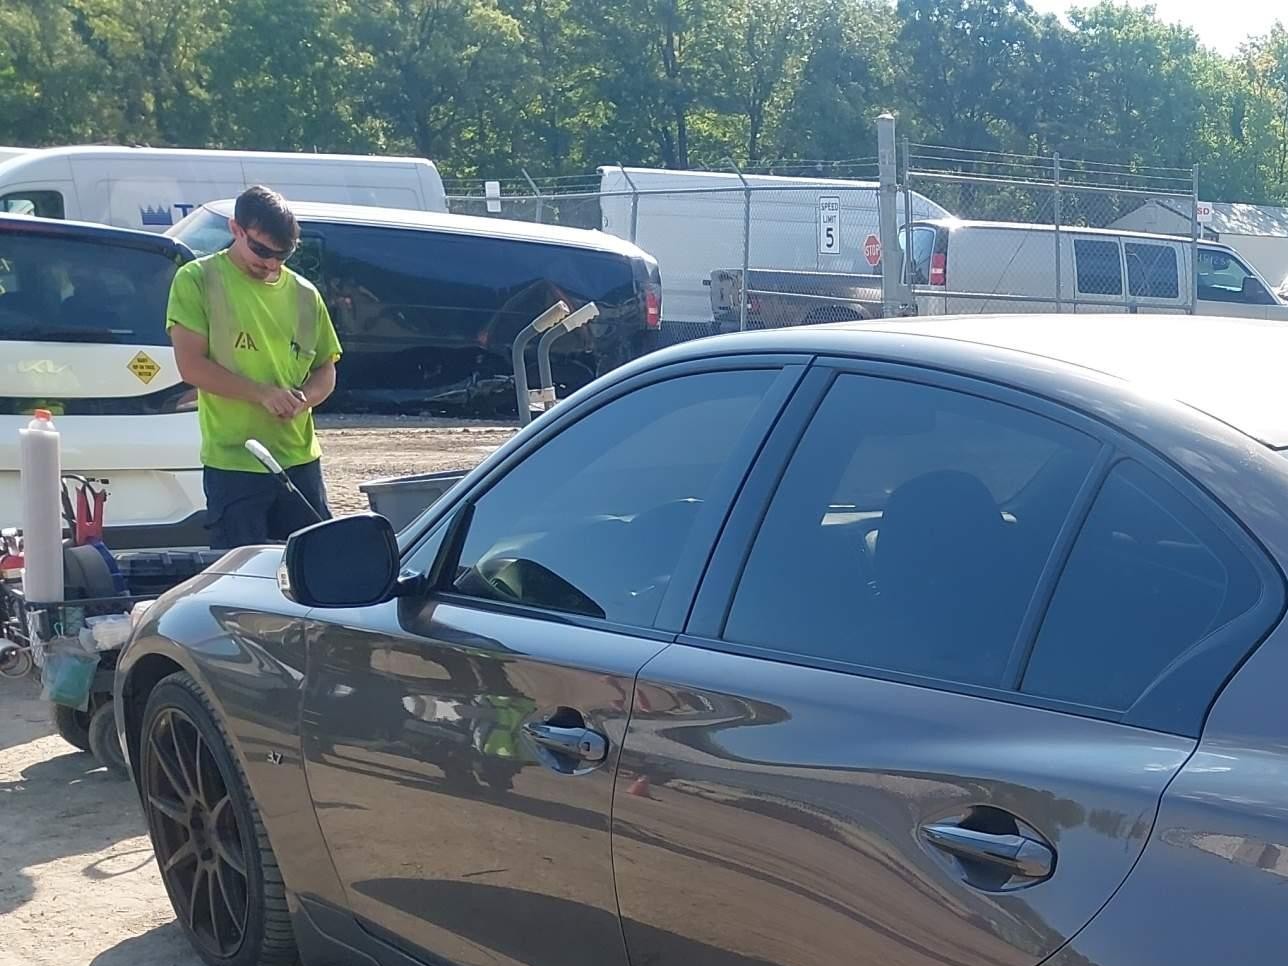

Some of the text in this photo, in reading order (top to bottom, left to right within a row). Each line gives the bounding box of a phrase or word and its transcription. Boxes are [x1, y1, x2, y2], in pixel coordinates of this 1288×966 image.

[821, 202, 838, 211] SPEED
[822, 215, 836, 224] LIMIT
[826, 227, 834, 248] 5
[865, 244, 880, 257] STOP
